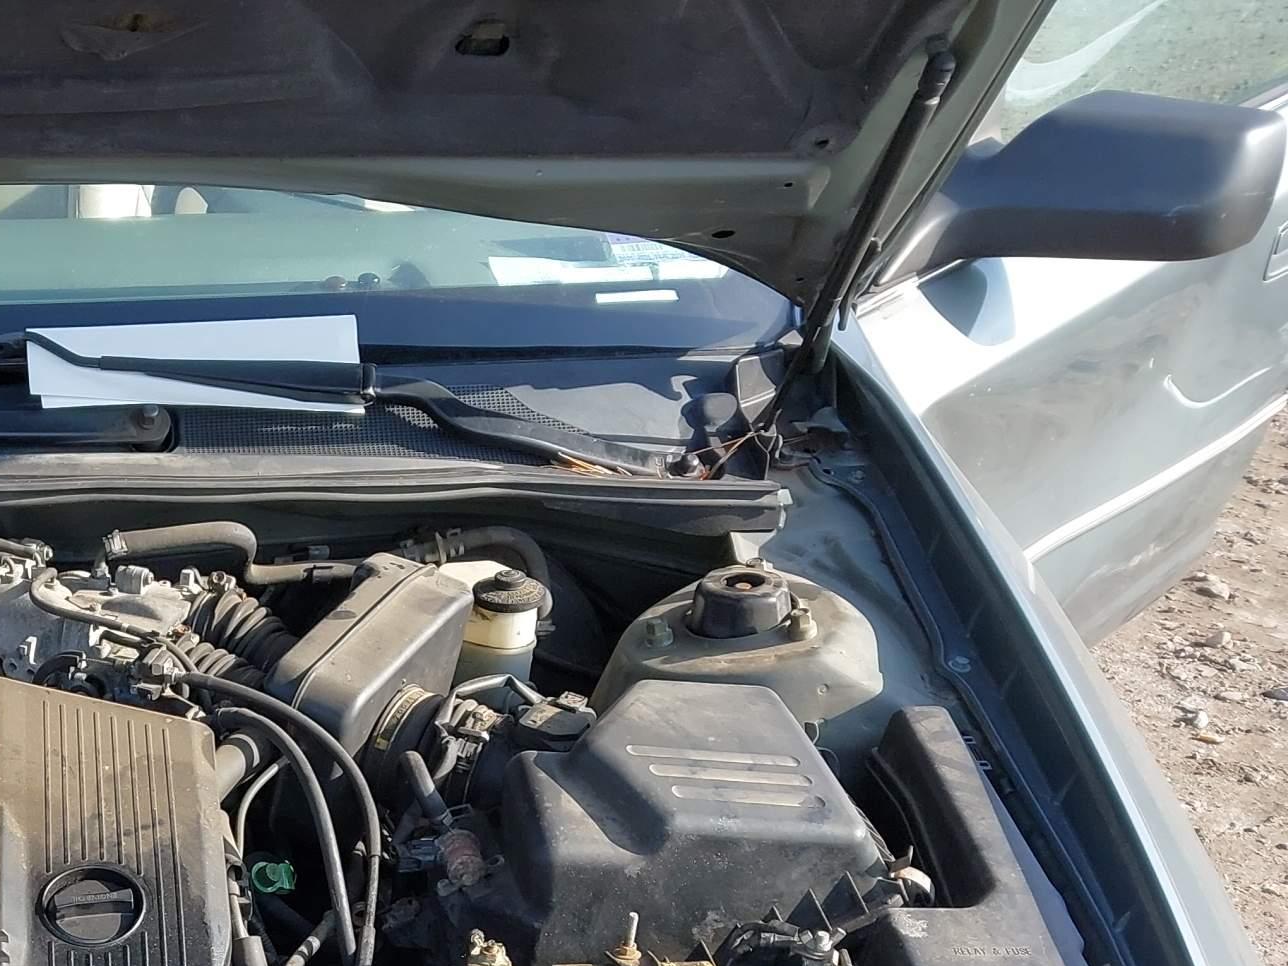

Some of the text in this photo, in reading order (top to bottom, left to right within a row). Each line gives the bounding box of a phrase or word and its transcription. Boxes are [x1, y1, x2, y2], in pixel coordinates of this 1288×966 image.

[952, 946, 1032, 957] RELAY & FUSE
